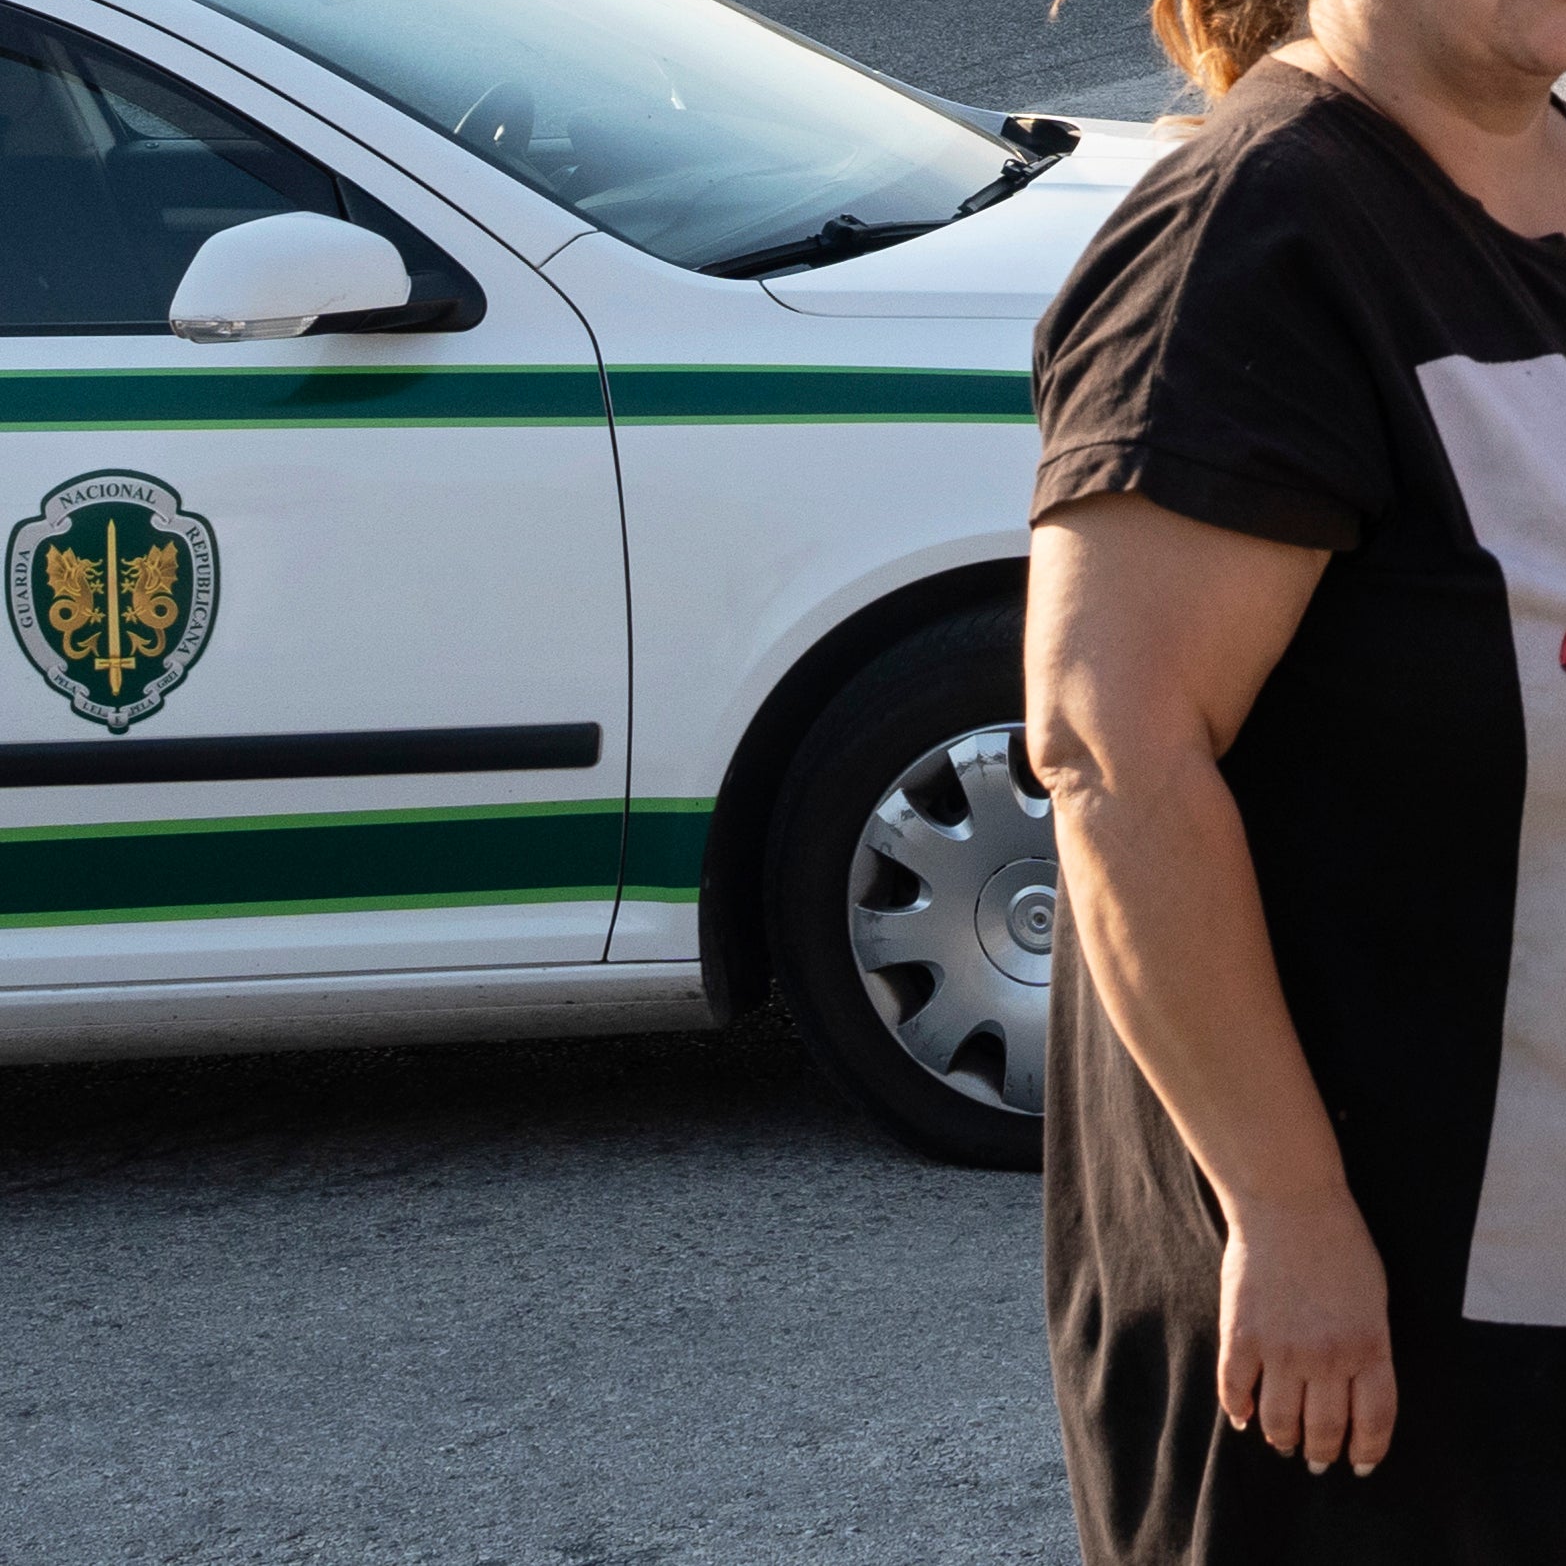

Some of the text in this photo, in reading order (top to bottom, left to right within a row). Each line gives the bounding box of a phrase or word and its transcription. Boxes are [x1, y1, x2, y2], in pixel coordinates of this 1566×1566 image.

[14, 483, 212, 656] GUARDA NACIONAL REPUBLICANA
